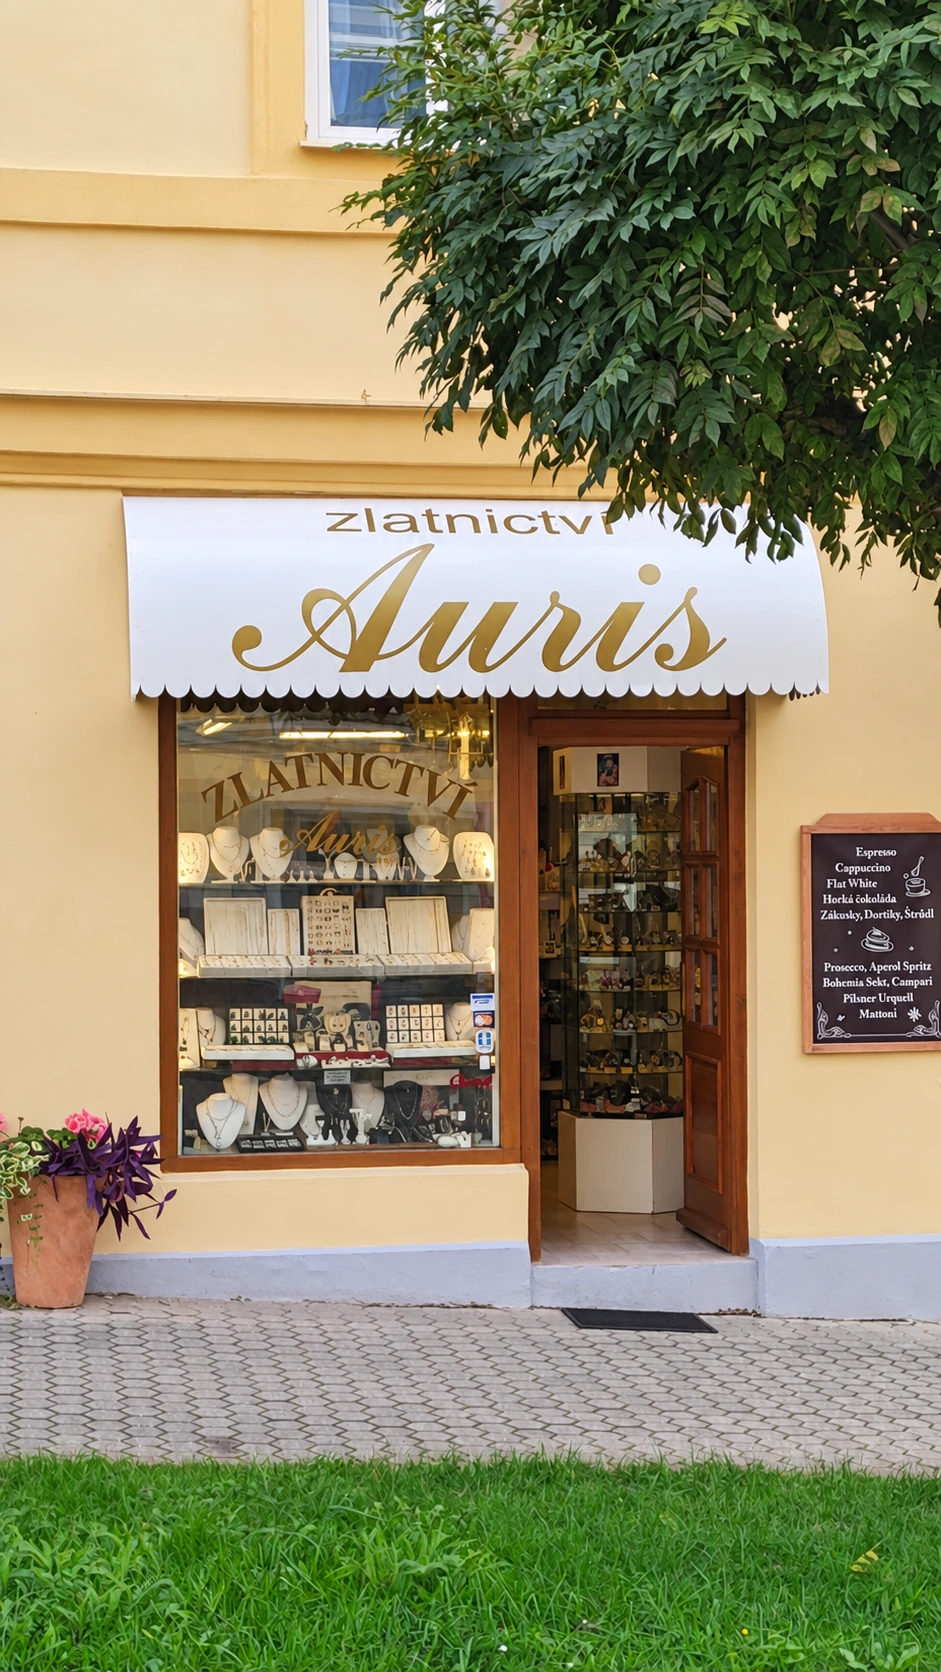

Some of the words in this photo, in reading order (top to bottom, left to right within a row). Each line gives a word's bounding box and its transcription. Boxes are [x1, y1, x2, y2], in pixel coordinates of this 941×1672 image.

[232, 543, 727, 673] Auris
[201, 752, 478, 823] ZLATNICTVÍ
[279, 808, 402, 858] Auris
[855, 847, 897, 859] Espresso
[835, 863, 891, 876] Cappuccino
[826, 879, 847, 889] Flat
[848, 878, 878, 888] White
[823, 894, 854, 904] Horká
[824, 962, 868, 973] Prosecco,
[869, 961, 901, 974] Aperol
[902, 960, 933, 974] Spritz
[823, 977, 864, 988] Bohemia
[865, 976, 890, 988] Sekt,
[891, 976, 933, 989] Campari
[843, 993, 877, 1003] Pilsner
[878, 992, 914, 1005] Urquell
[859, 1008, 898, 1019] Mattoni
